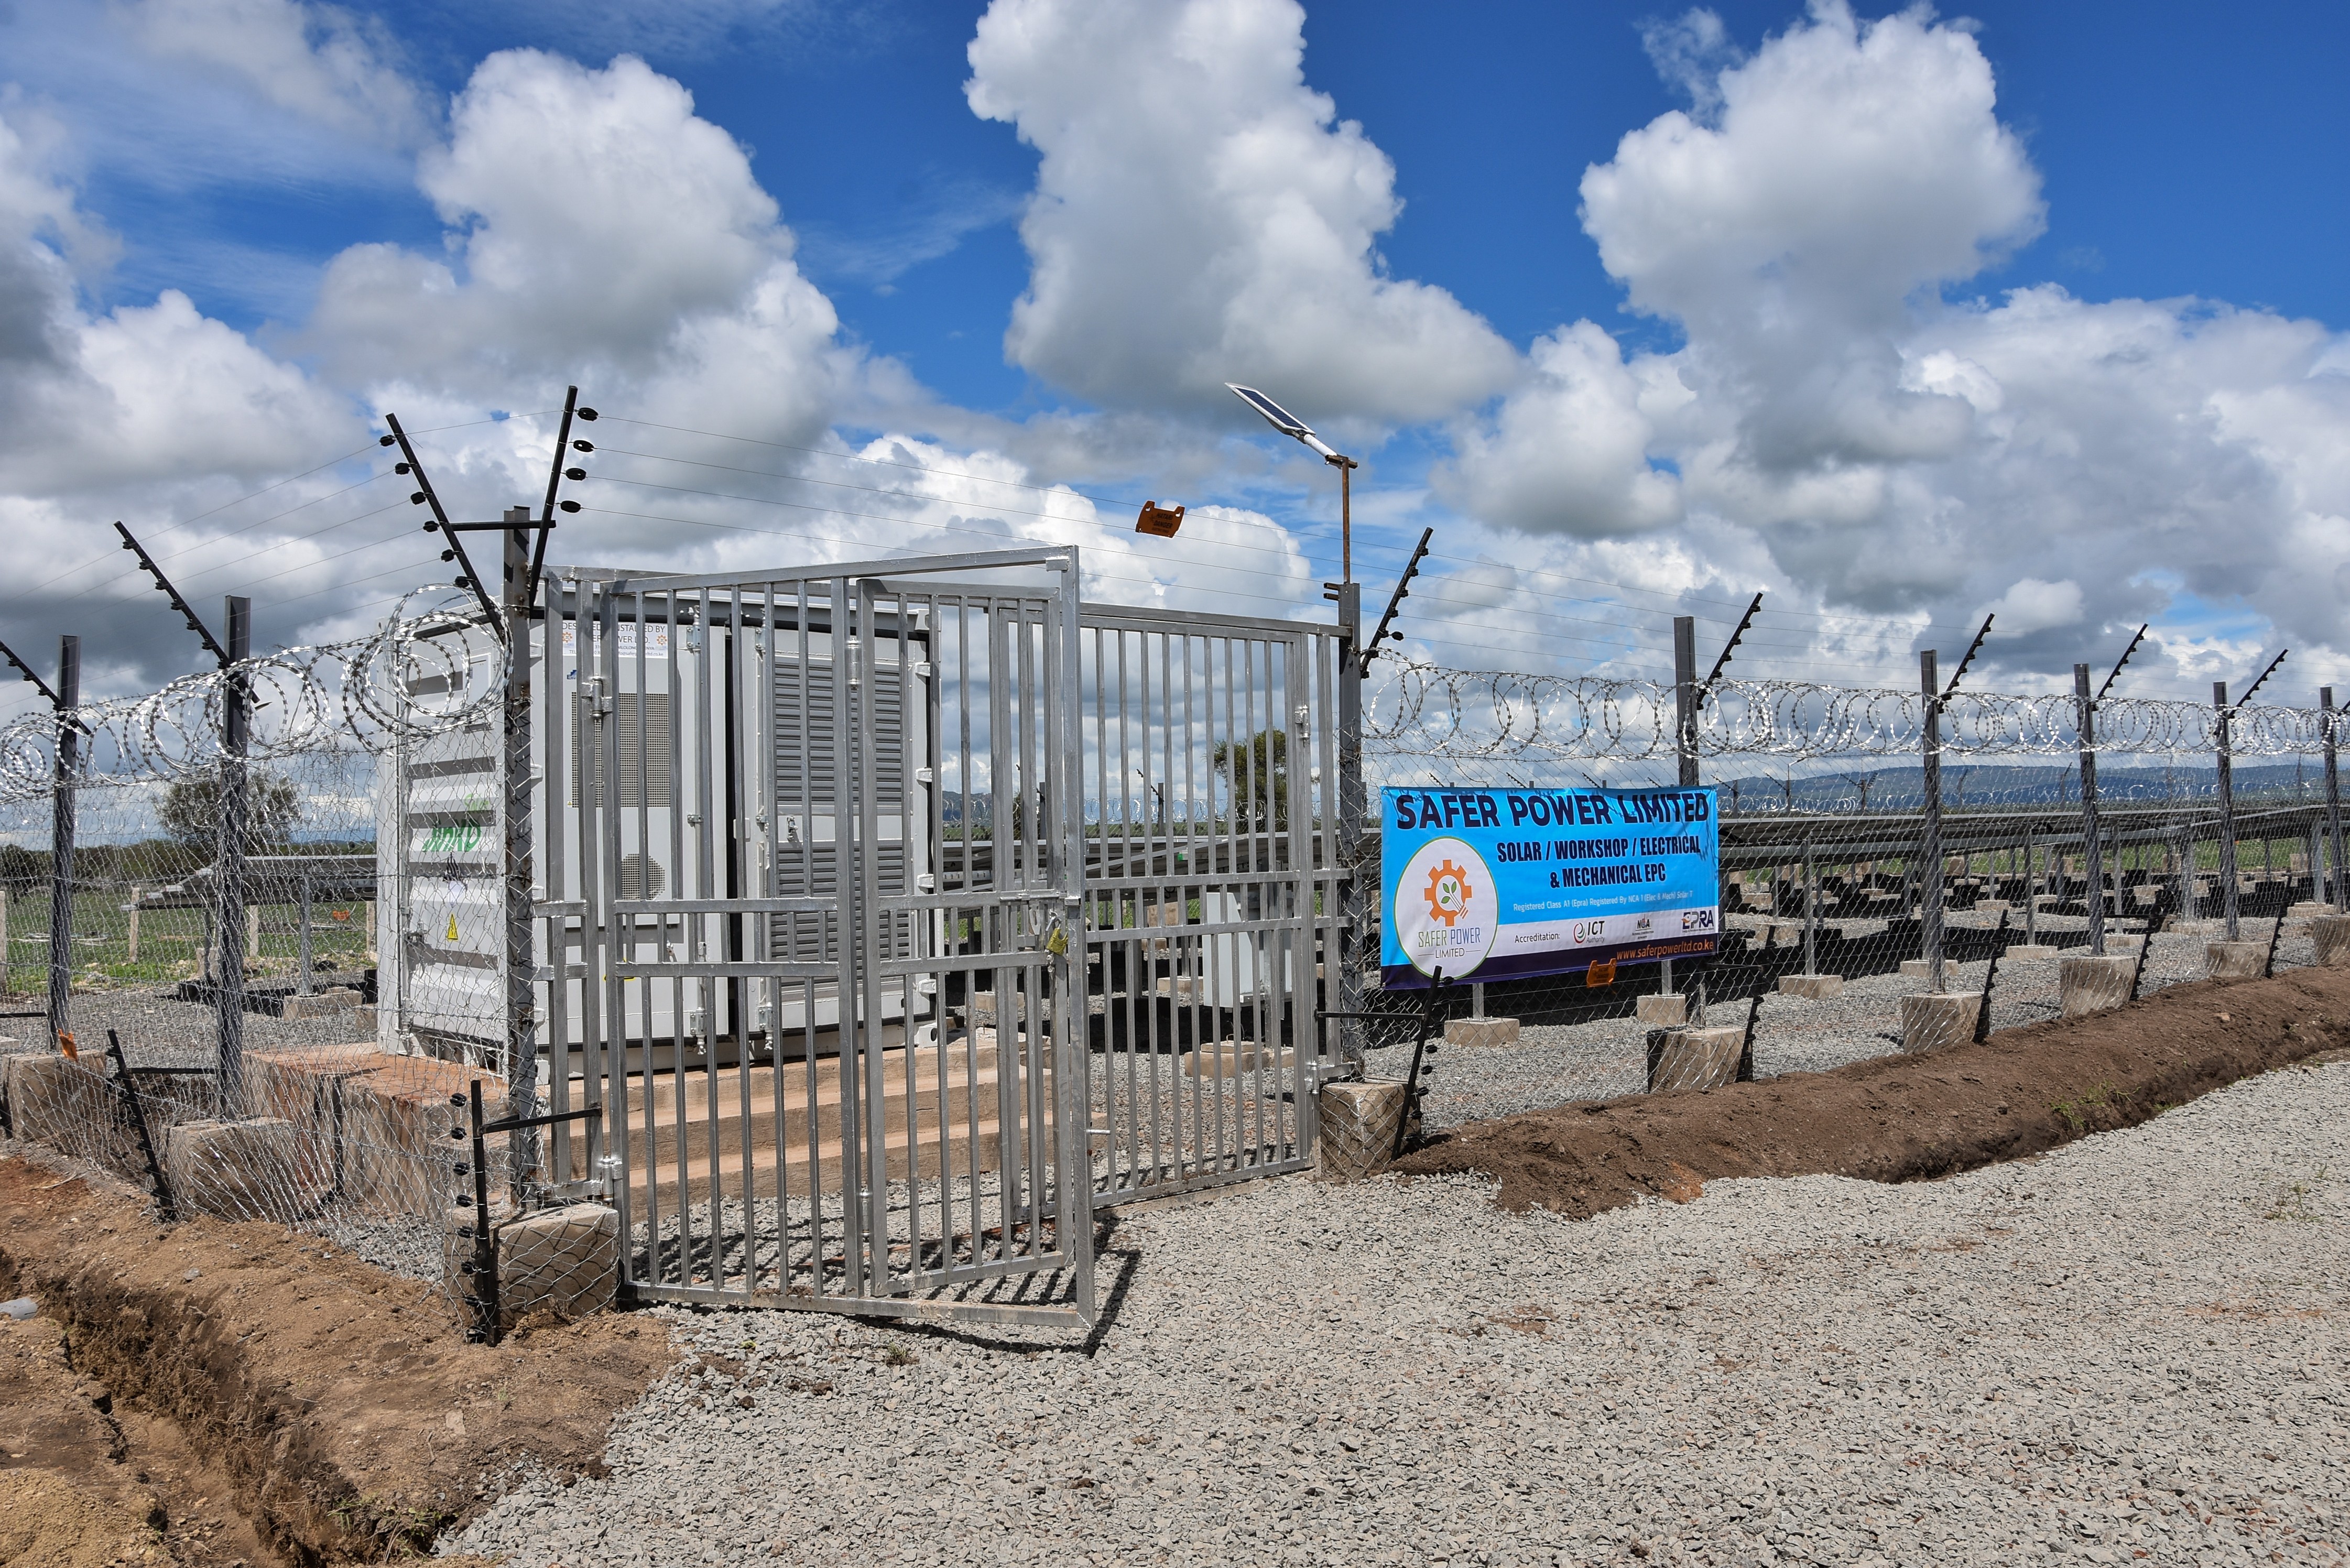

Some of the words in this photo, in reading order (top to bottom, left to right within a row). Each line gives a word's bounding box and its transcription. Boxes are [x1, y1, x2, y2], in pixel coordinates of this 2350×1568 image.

[1154, 520, 1173, 529] DANGER
[1396, 794, 1502, 830] SAFER
[1507, 794, 1613, 826] POWER
[1617, 792, 1709, 824] LIMITED
[1496, 842, 1542, 863] SOLAR
[1546, 841, 1551, 861] /
[1554, 838, 1628, 860] WORKSHOP
[1631, 837, 1637, 857] /
[1640, 835, 1701, 856] ELECTRICAL
[1550, 872, 1560, 889] &
[1562, 864, 1642, 888] MECHANICAL
[1645, 863, 1666, 881] EPC
[1513, 901, 1545, 912] Registered
[1572, 898, 1588, 908] (Epra)
[1590, 896, 1618, 907] Registered
[1619, 896, 1626, 905] By
[1644, 894, 1656, 902] (Elec
[1587, 921, 1605, 936] ICT
[1682, 909, 1714, 930] EPRA
[1418, 930, 1447, 948] SAFER
[1451, 927, 1481, 945] POWER
[1515, 932, 1560, 943] Accreditation:
[1586, 935, 1605, 944] Authority
[1435, 948, 1465, 959] LIMITED
[1617, 939, 1714, 960] www.saferpowerltd.co.ke
